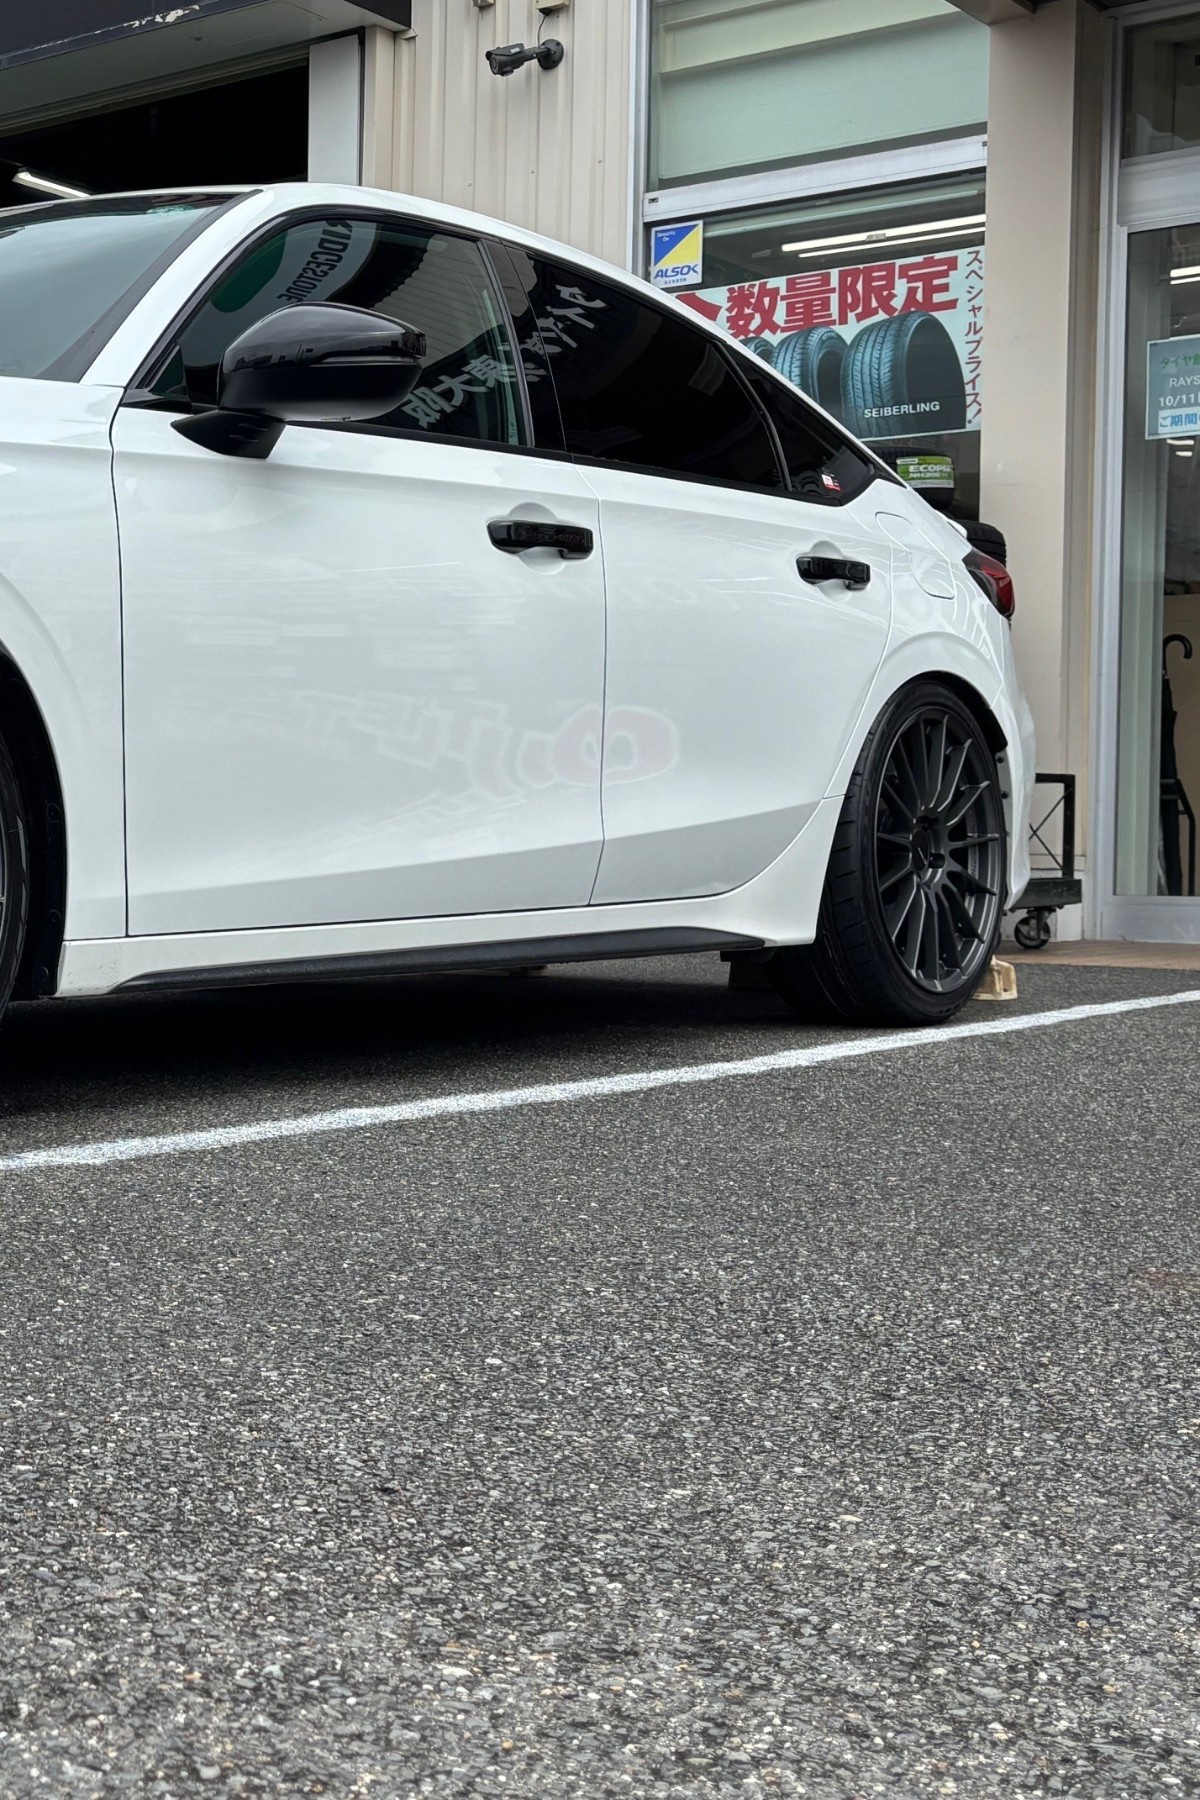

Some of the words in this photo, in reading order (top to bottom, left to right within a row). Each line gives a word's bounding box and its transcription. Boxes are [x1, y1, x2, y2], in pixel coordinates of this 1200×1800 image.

[654, 264, 699, 280] ALSOK
[675, 255, 960, 340] 数量限定
[1159, 392, 1200, 407] 10/11
[863, 401, 940, 418] SEIBERLING
[1160, 413, 1200, 428] ご期間
